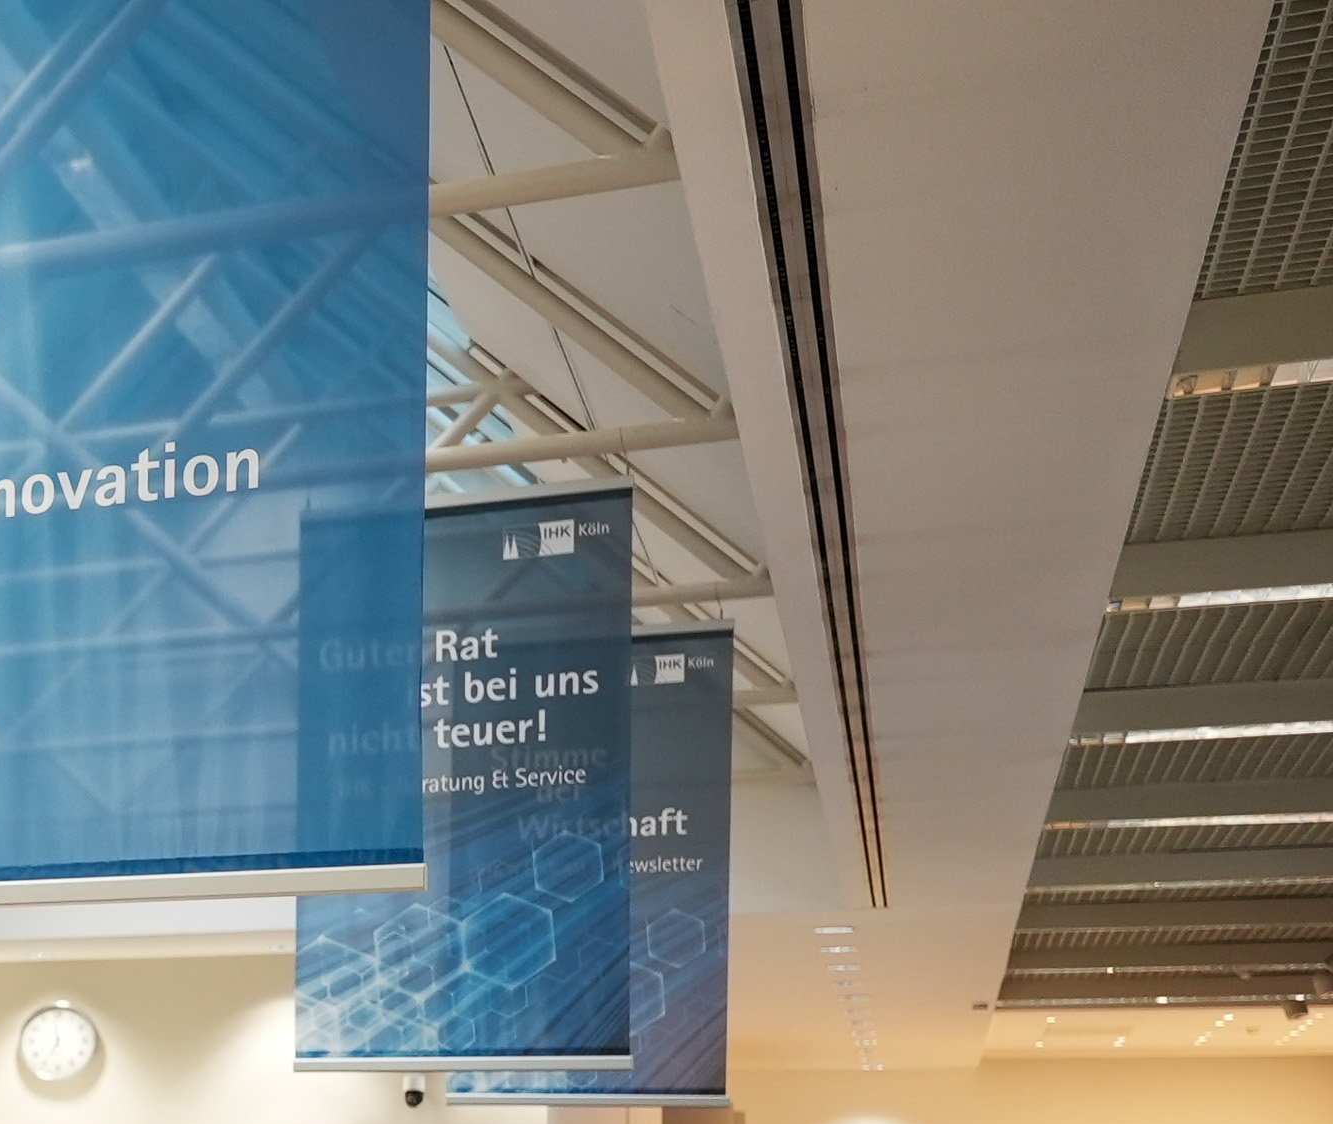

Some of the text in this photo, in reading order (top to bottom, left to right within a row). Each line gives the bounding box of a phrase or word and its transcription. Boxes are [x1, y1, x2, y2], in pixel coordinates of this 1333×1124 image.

[543, 521, 610, 540] IHK Köln
[435, 627, 499, 663] Rat
[658, 656, 715, 671] IHK Köln
[464, 668, 517, 703] bei
[534, 669, 599, 698] uns
[433, 710, 547, 749] teuer!
[421, 764, 587, 796] ratung & Service
[629, 855, 703, 875] ewsletter
